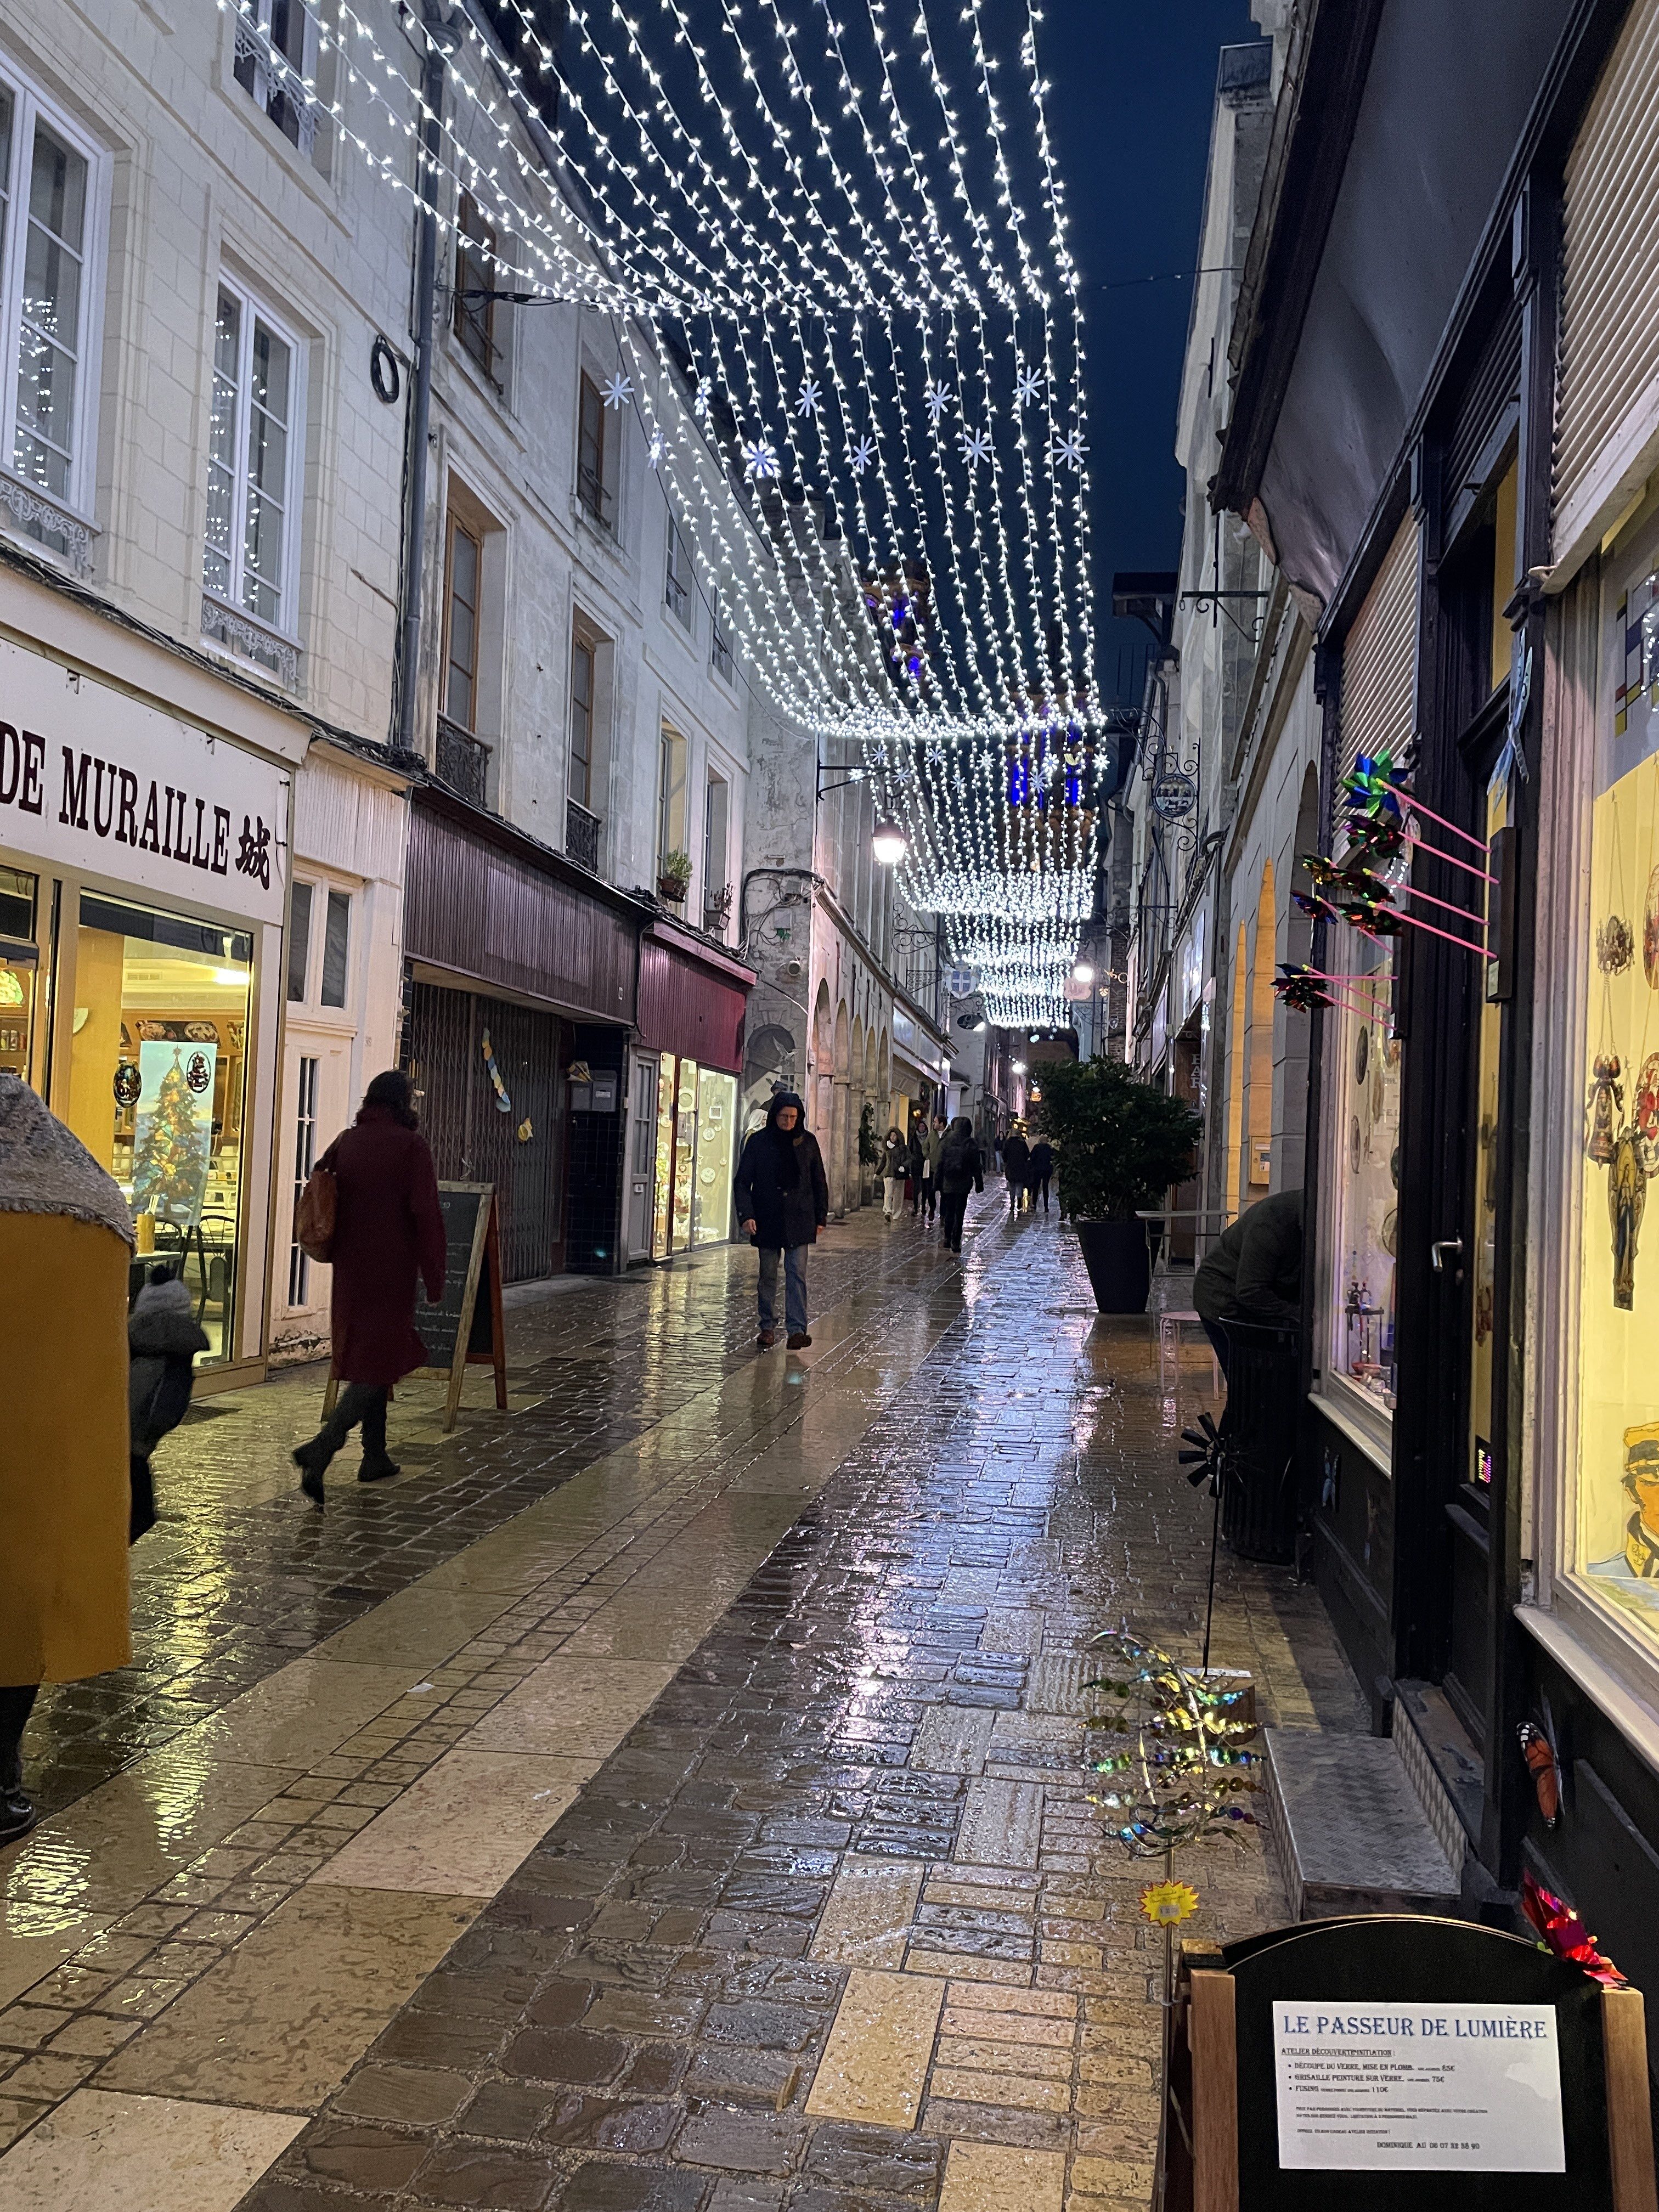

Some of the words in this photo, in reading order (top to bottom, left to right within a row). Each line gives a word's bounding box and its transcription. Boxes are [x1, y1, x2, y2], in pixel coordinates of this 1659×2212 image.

[0, 720, 46, 815] DE
[59, 745, 230, 876] MURAILLE
[235, 815, 270, 890] 城
[1282, 2047, 1310, 2056] ATELIER
[1284, 2016, 1309, 2034] LE
[1317, 2017, 1415, 2036] PASSEUR
[1422, 2018, 1448, 2036] DE
[1455, 2016, 1547, 2039] LUMIÈRE
